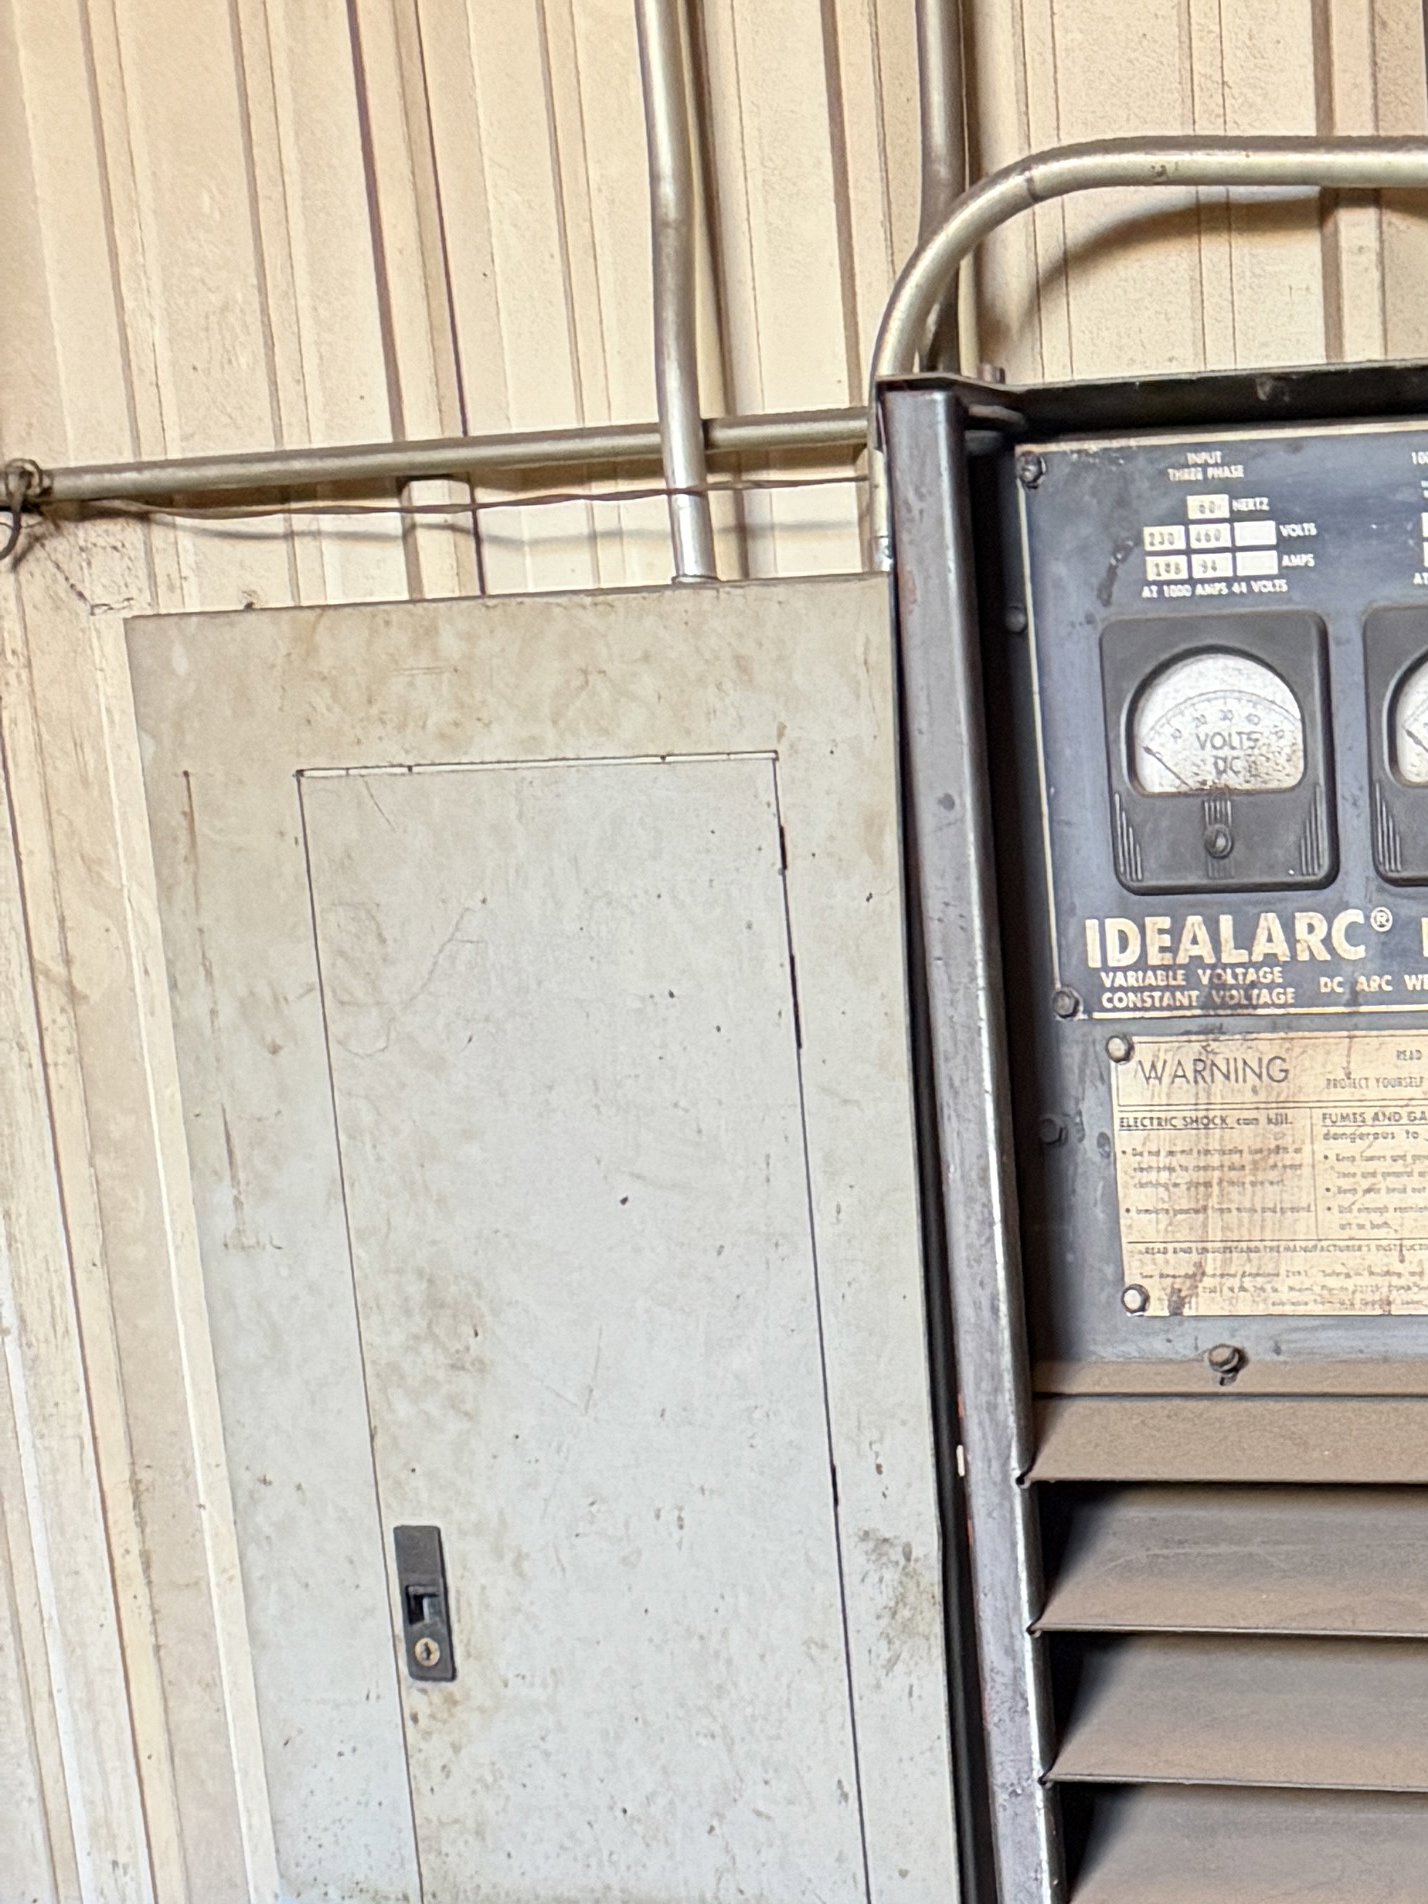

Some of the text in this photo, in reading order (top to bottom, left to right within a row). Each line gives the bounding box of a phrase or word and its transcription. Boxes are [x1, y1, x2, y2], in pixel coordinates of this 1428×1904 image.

[1187, 451, 1222, 465] INPUT
[1279, 523, 1318, 538] VOLTS
[1282, 553, 1316, 567] AMPS
[1250, 579, 1289, 593] VOLTS
[1196, 730, 1264, 751] VOLTS
[1100, 966, 1284, 988] VARIABLE VOLTAGE
[1319, 976, 1345, 994] DC
[1355, 974, 1393, 993] ARC
[1100, 987, 1297, 1009] CONSTANT VOLTAGE
[1138, 1055, 1291, 1086] WARNING
[1119, 1115, 1178, 1129] ELECTRIC
[1182, 1114, 1229, 1128] SHOCK
[1321, 1111, 1365, 1125] FUMES
[1371, 1110, 1402, 1124] AND
[1321, 1128, 1396, 1144] dangerous
